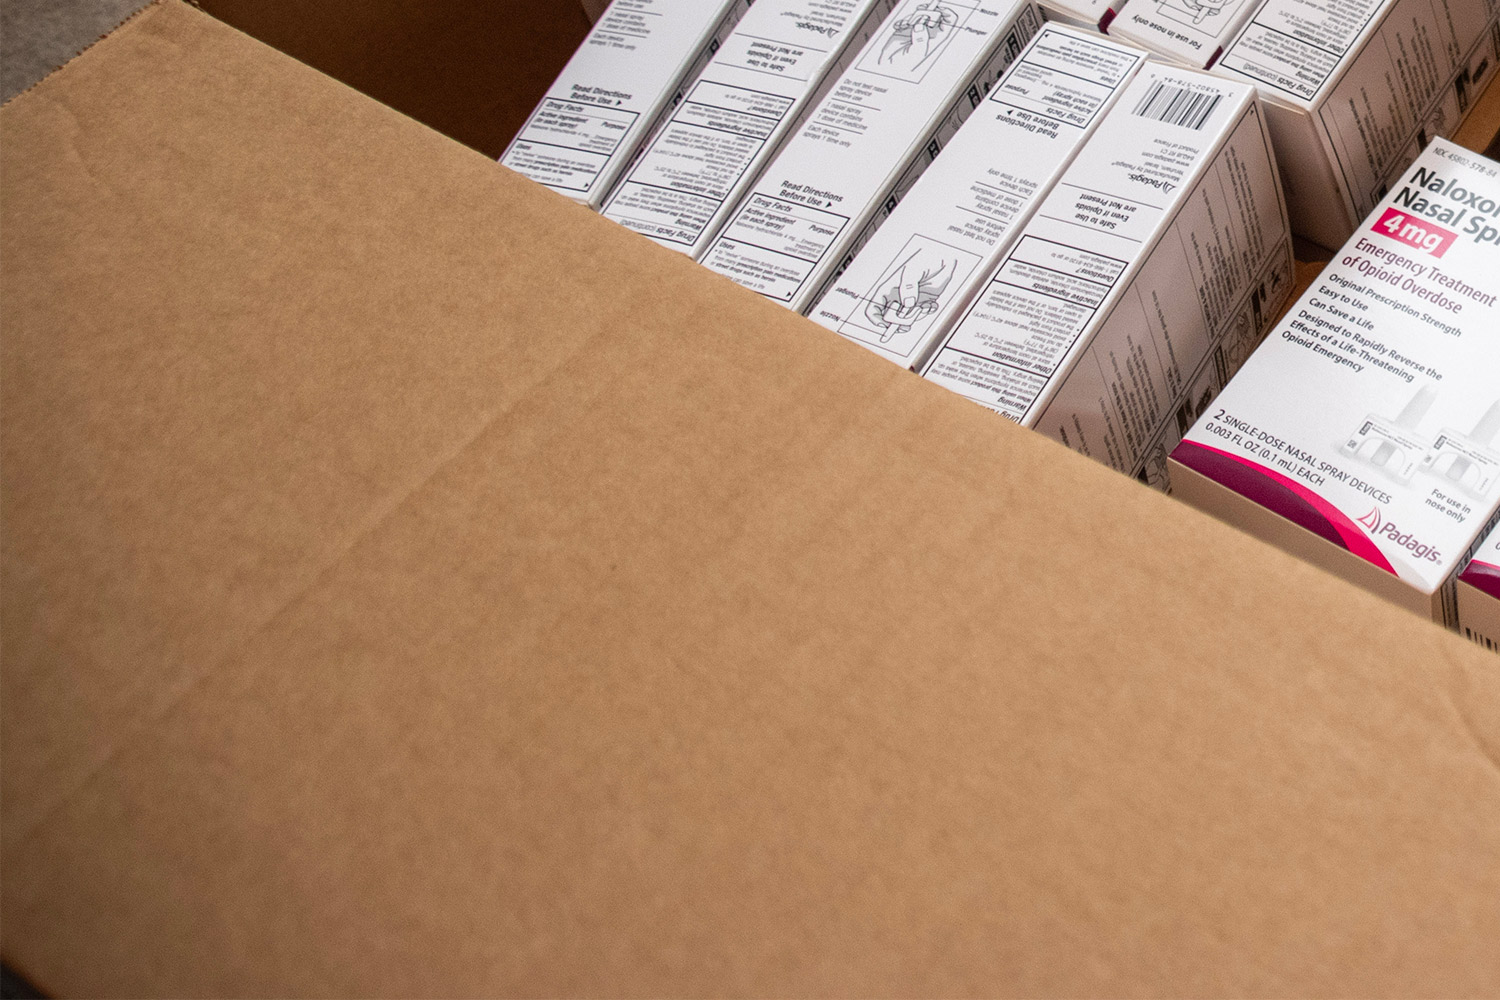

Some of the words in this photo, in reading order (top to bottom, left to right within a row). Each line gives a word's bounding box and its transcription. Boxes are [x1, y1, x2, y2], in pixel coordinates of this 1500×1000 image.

[1132, 15, 1148, 27] only
[1149, 23, 1166, 34] nose
[965, 26, 988, 36] Plunger
[1167, 30, 1173, 38] in
[1175, 34, 1190, 44] use
[1190, 40, 1203, 50] For
[779, 189, 806, 203] Before
[807, 197, 822, 207] Use
[781, 180, 803, 191] Read
[805, 185, 843, 203] Directions
[753, 197, 773, 209] Drug
[774, 201, 793, 213] Facts
[1079, 193, 1108, 207] Present
[1108, 200, 1123, 210] Not
[1393, 186, 1466, 226] Nasal
[1075, 202, 1102, 215] Opioids
[1123, 204, 1137, 213] are
[1074, 212, 1089, 222] Use
[1110, 211, 1130, 223] Even
[808, 224, 835, 236] Purpose
[1100, 220, 1117, 230] Safe
[1354, 237, 1427, 276] Emergency
[1428, 267, 1496, 307] Treatment
[1341, 256, 1362, 268] of
[1357, 259, 1403, 286] Opioid
[1401, 278, 1462, 314] Overdose
[1318, 285, 1341, 300] Easy
[1339, 294, 1351, 304] to
[1351, 298, 1369, 311] Use
[1328, 273, 1367, 293] Original
[1365, 288, 1420, 317] Prescription
[1420, 313, 1461, 337] Strength
[1308, 297, 1327, 310] Can
[1326, 305, 1349, 320] Save
[1356, 317, 1374, 330] Life
[1281, 330, 1315, 349] Opioid
[1312, 343, 1364, 373] Emergency
[1289, 319, 1320, 338] Effects
[1320, 334, 1334, 343] of
[1338, 341, 1414, 383] Life-Threatening
[1298, 309, 1343, 333] Designed
[1341, 328, 1352, 338] to
[1352, 333, 1388, 355] Rapidly
[1388, 349, 1425, 372] Reverse
[1426, 368, 1442, 380] the
[1205, 422, 1233, 440] 0.003
[1230, 433, 1243, 446] FL
[1243, 440, 1261, 454] OZ
[1258, 447, 1278, 462] (0.1
[1277, 458, 1298, 473] mL)
[1296, 466, 1325, 486] EACH
[1213, 408, 1226, 421] 2
[1222, 415, 1286, 451] SINGLE-DOSE
[1284, 444, 1317, 467] NASAL
[1317, 461, 1351, 482] SPRAY
[1349, 477, 1391, 504] DEVICES
